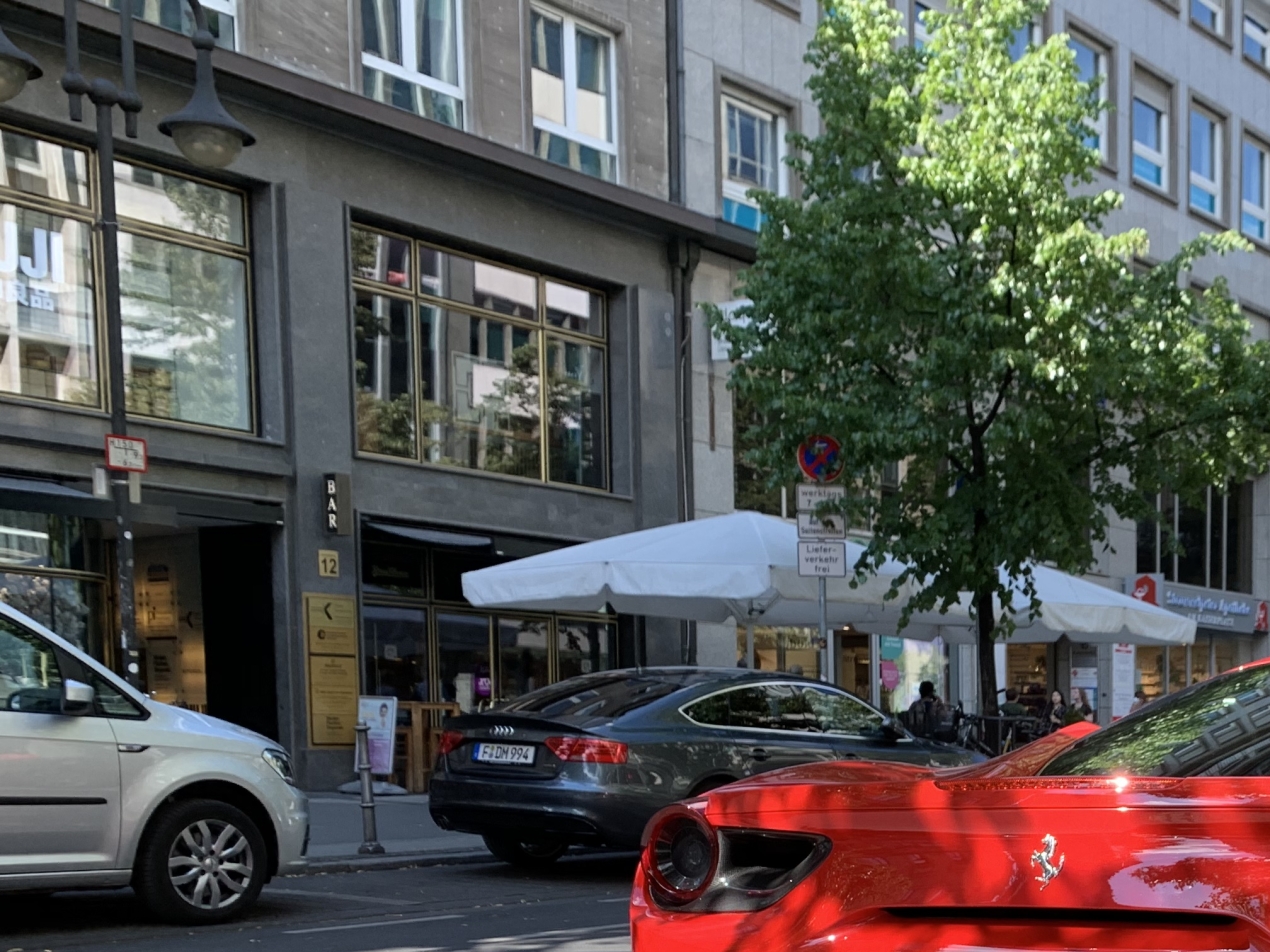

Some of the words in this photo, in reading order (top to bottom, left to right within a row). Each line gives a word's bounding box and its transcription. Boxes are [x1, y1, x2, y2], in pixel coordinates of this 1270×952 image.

[326, 479, 337, 528] BAR
[806, 545, 837, 554] Liefer-
[321, 558, 337, 574] 12
[805, 556, 839, 564] verkehr
[815, 565, 830, 573] frei
[482, 745, 490, 758] F
[495, 746, 509, 759] DM
[510, 747, 529, 761] 994
